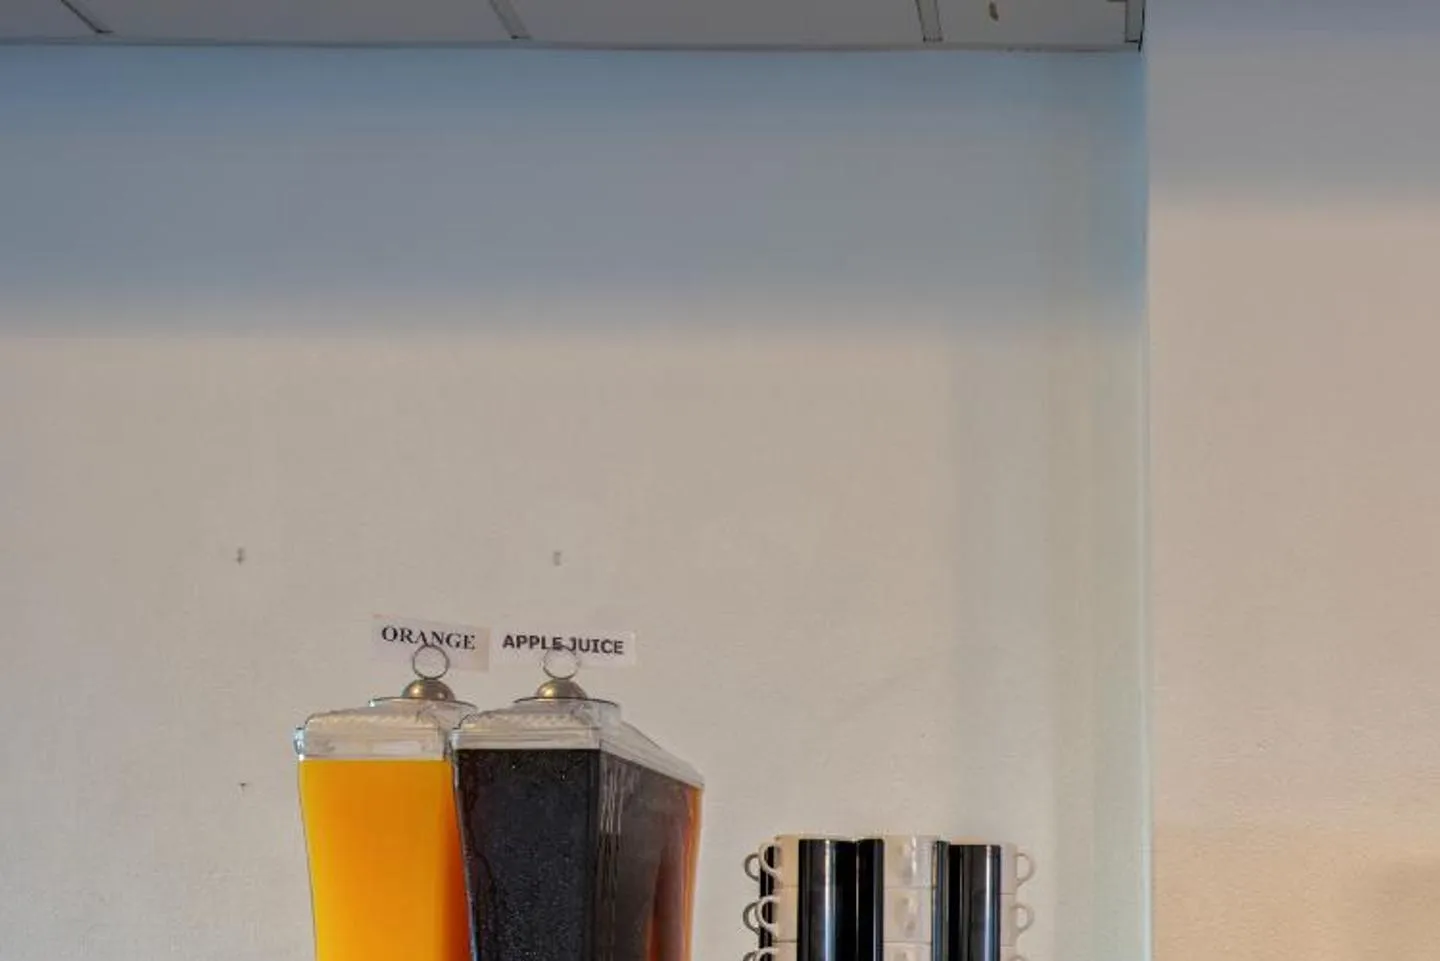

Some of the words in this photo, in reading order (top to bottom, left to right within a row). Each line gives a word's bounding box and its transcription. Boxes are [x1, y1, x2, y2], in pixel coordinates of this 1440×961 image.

[381, 625, 476, 650] ORANGE
[502, 634, 563, 651] APPLE
[567, 636, 625, 655] JUICE
